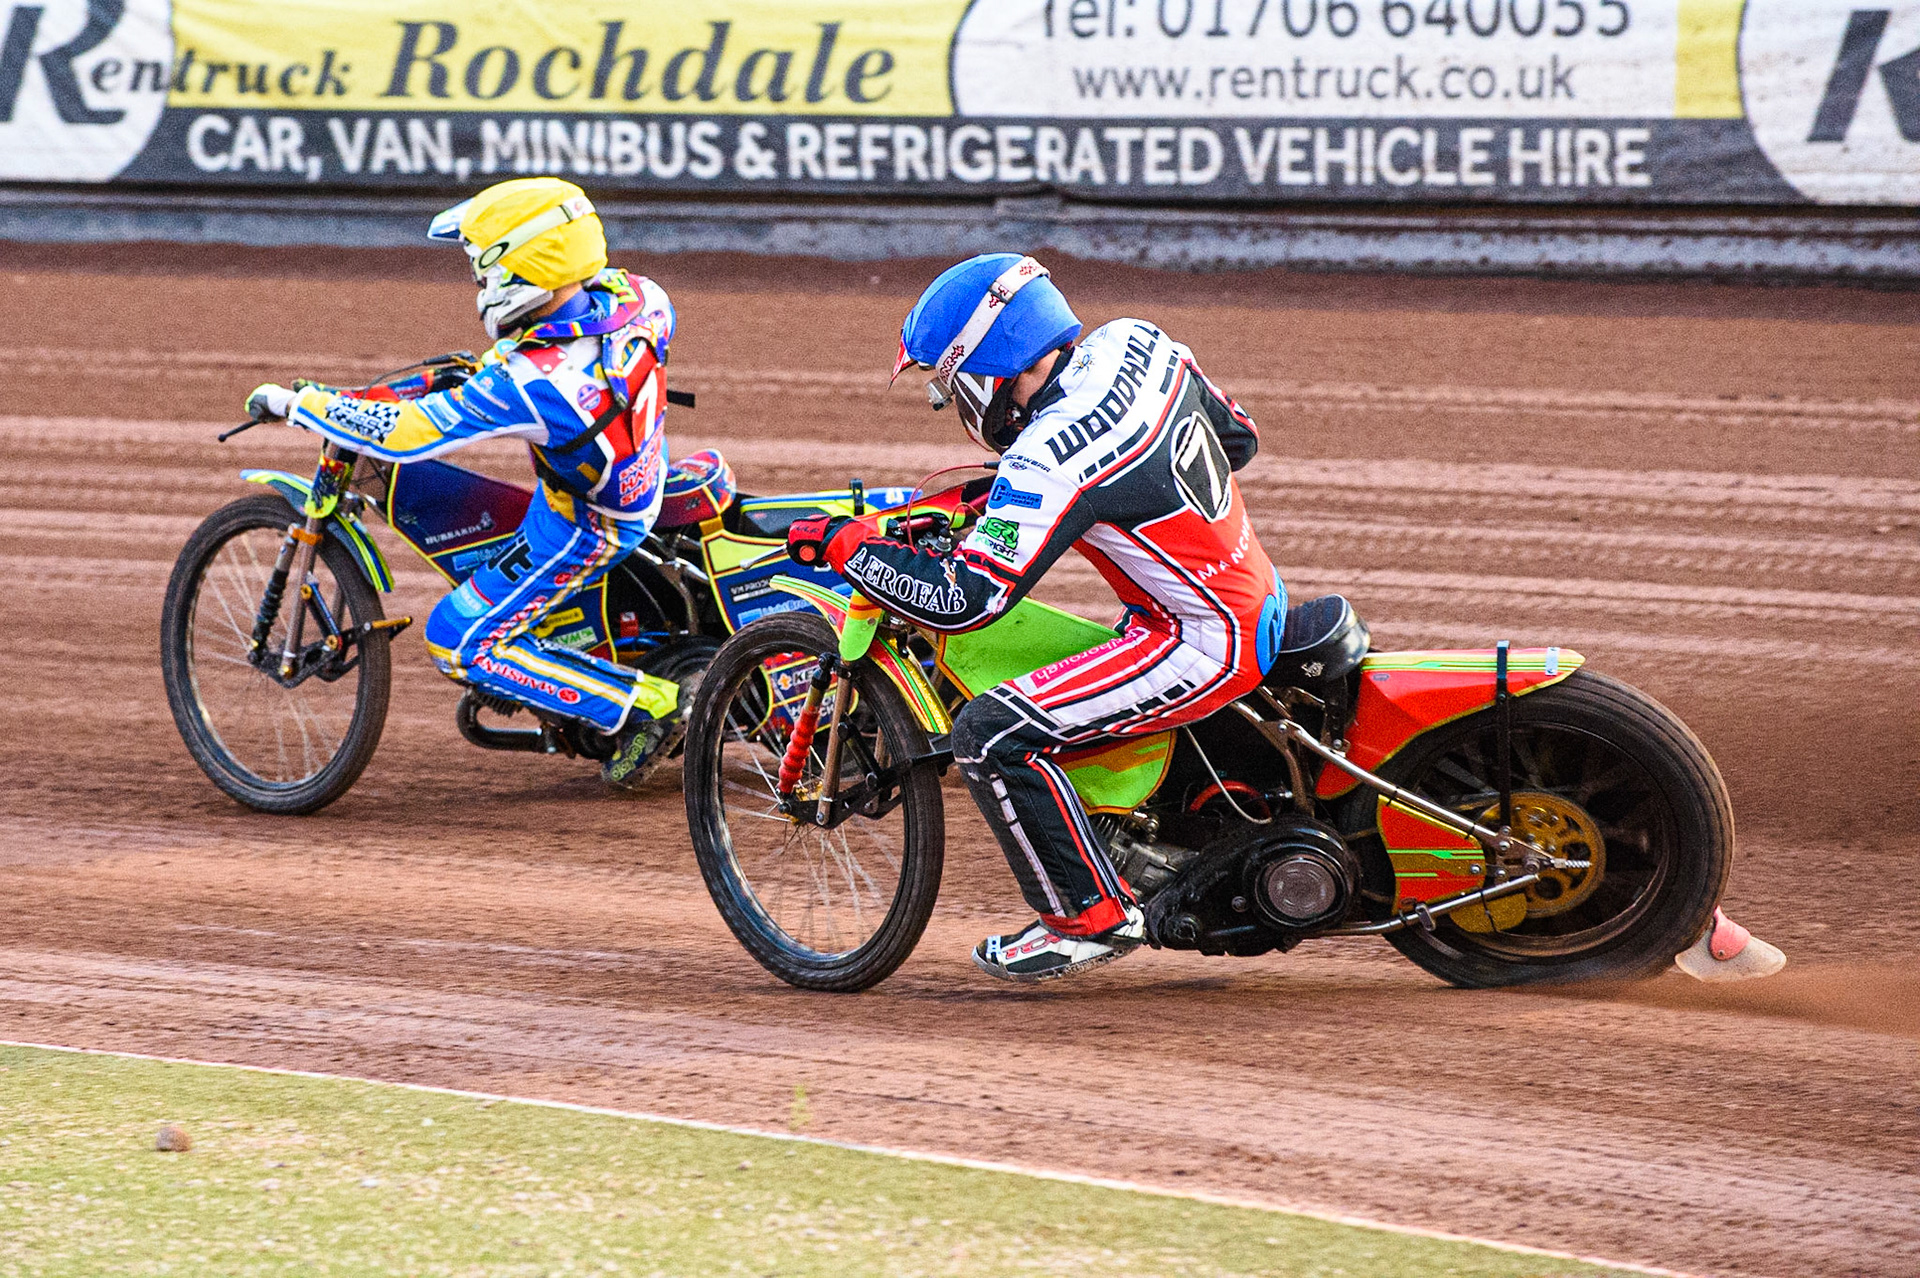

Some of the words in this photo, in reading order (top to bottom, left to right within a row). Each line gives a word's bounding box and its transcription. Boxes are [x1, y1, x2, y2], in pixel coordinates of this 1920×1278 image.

[1157, 0, 1359, 38] 01706
[1382, 0, 1630, 38] 640055
[379, 19, 896, 103] Rochdale
[1072, 55, 1577, 101] www.rentruck.co.uk
[186, 114, 322, 182] CAR,
[328, 117, 471, 183] VAN,
[480, 119, 726, 178] MINIBUS
[733, 122, 777, 181] &
[787, 124, 1222, 185] REFRIGERATED
[1233, 128, 1497, 186] VEHICLE
[1508, 129, 1654, 187] HIRE
[1044, 324, 1161, 466] WOODHULL
[1179, 420, 1223, 511] 7
[848, 546, 967, 615] AEROFAB
